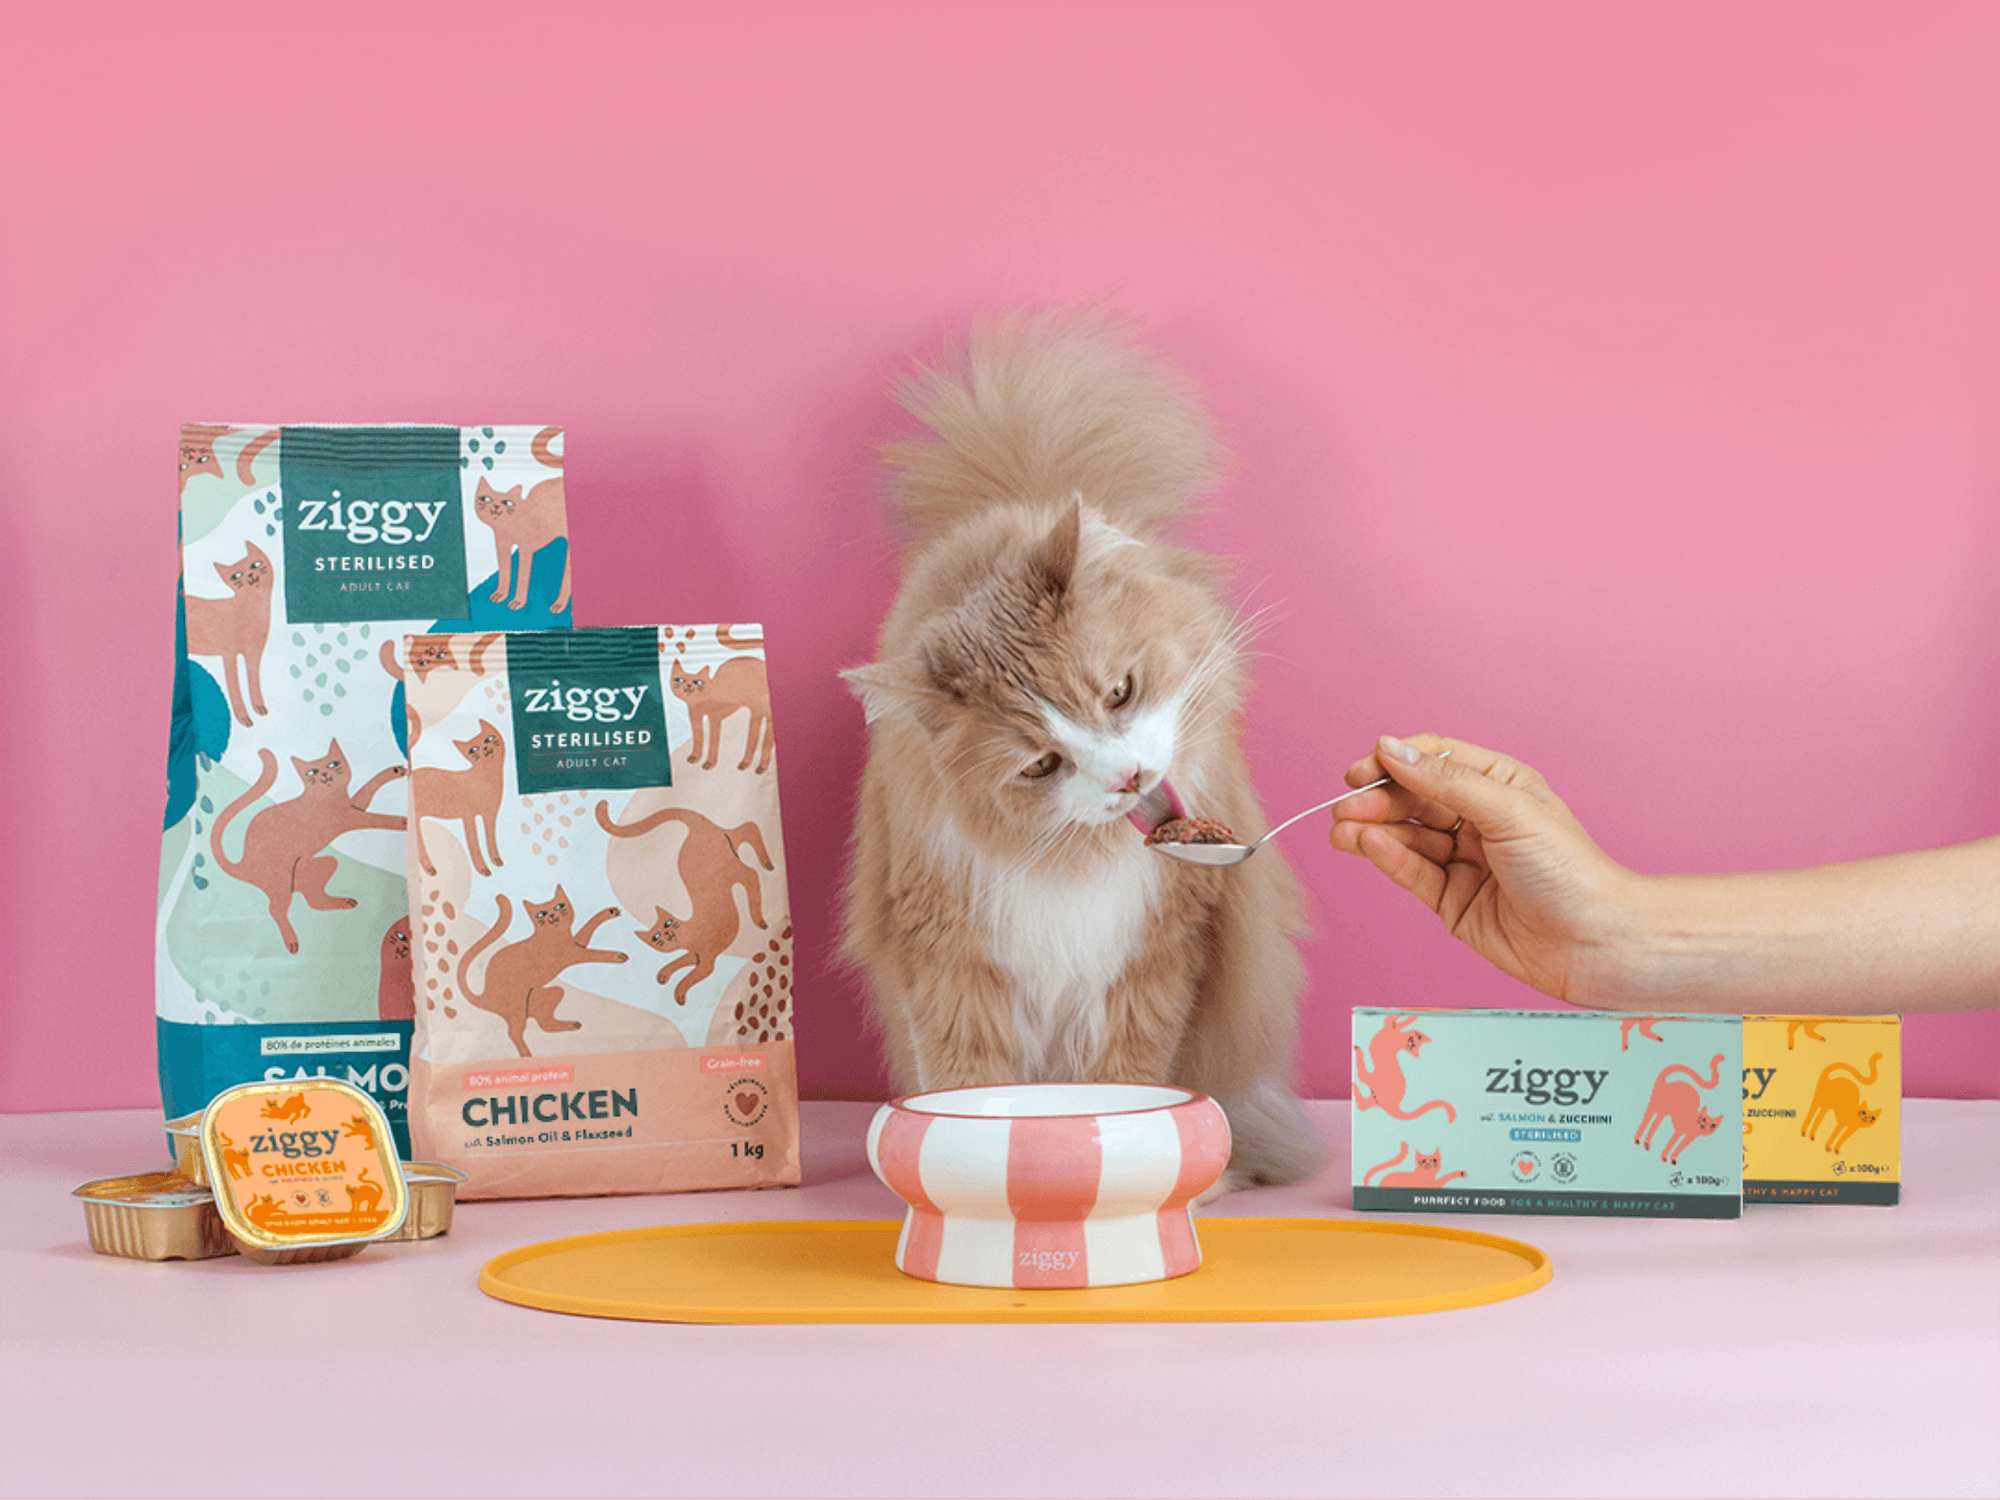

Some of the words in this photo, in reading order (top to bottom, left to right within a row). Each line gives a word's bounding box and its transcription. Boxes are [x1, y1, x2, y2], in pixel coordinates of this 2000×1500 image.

[298, 490, 447, 545] ziggy
[315, 555, 435, 572] STERILISED
[339, 583, 381, 592] ADULT
[386, 581, 411, 591] CAT
[524, 680, 648, 722] ziggy
[531, 730, 651, 749] STERILISED
[556, 758, 598, 769] ADULT
[603, 757, 627, 768] CAT
[1485, 1059, 1609, 1105] ziggy
[462, 1088, 638, 1127] CHICKEN
[1498, 1113, 1546, 1122] SALMON
[1559, 1114, 1612, 1124] ZUCCHINI
[250, 1127, 340, 1159] ziggy
[486, 1131, 535, 1146] Salmon
[538, 1131, 558, 1143] Oil
[561, 1130, 571, 1141] &
[576, 1126, 632, 1141] Flaxseed
[731, 1144, 738, 1157] 1
[745, 1142, 764, 1160] kg
[262, 1160, 347, 1177] CHICKEN
[1782, 1188, 1816, 1197] HAPPY
[1819, 1188, 1840, 1197] CAT
[1018, 1247, 1080, 1271] ziggy
